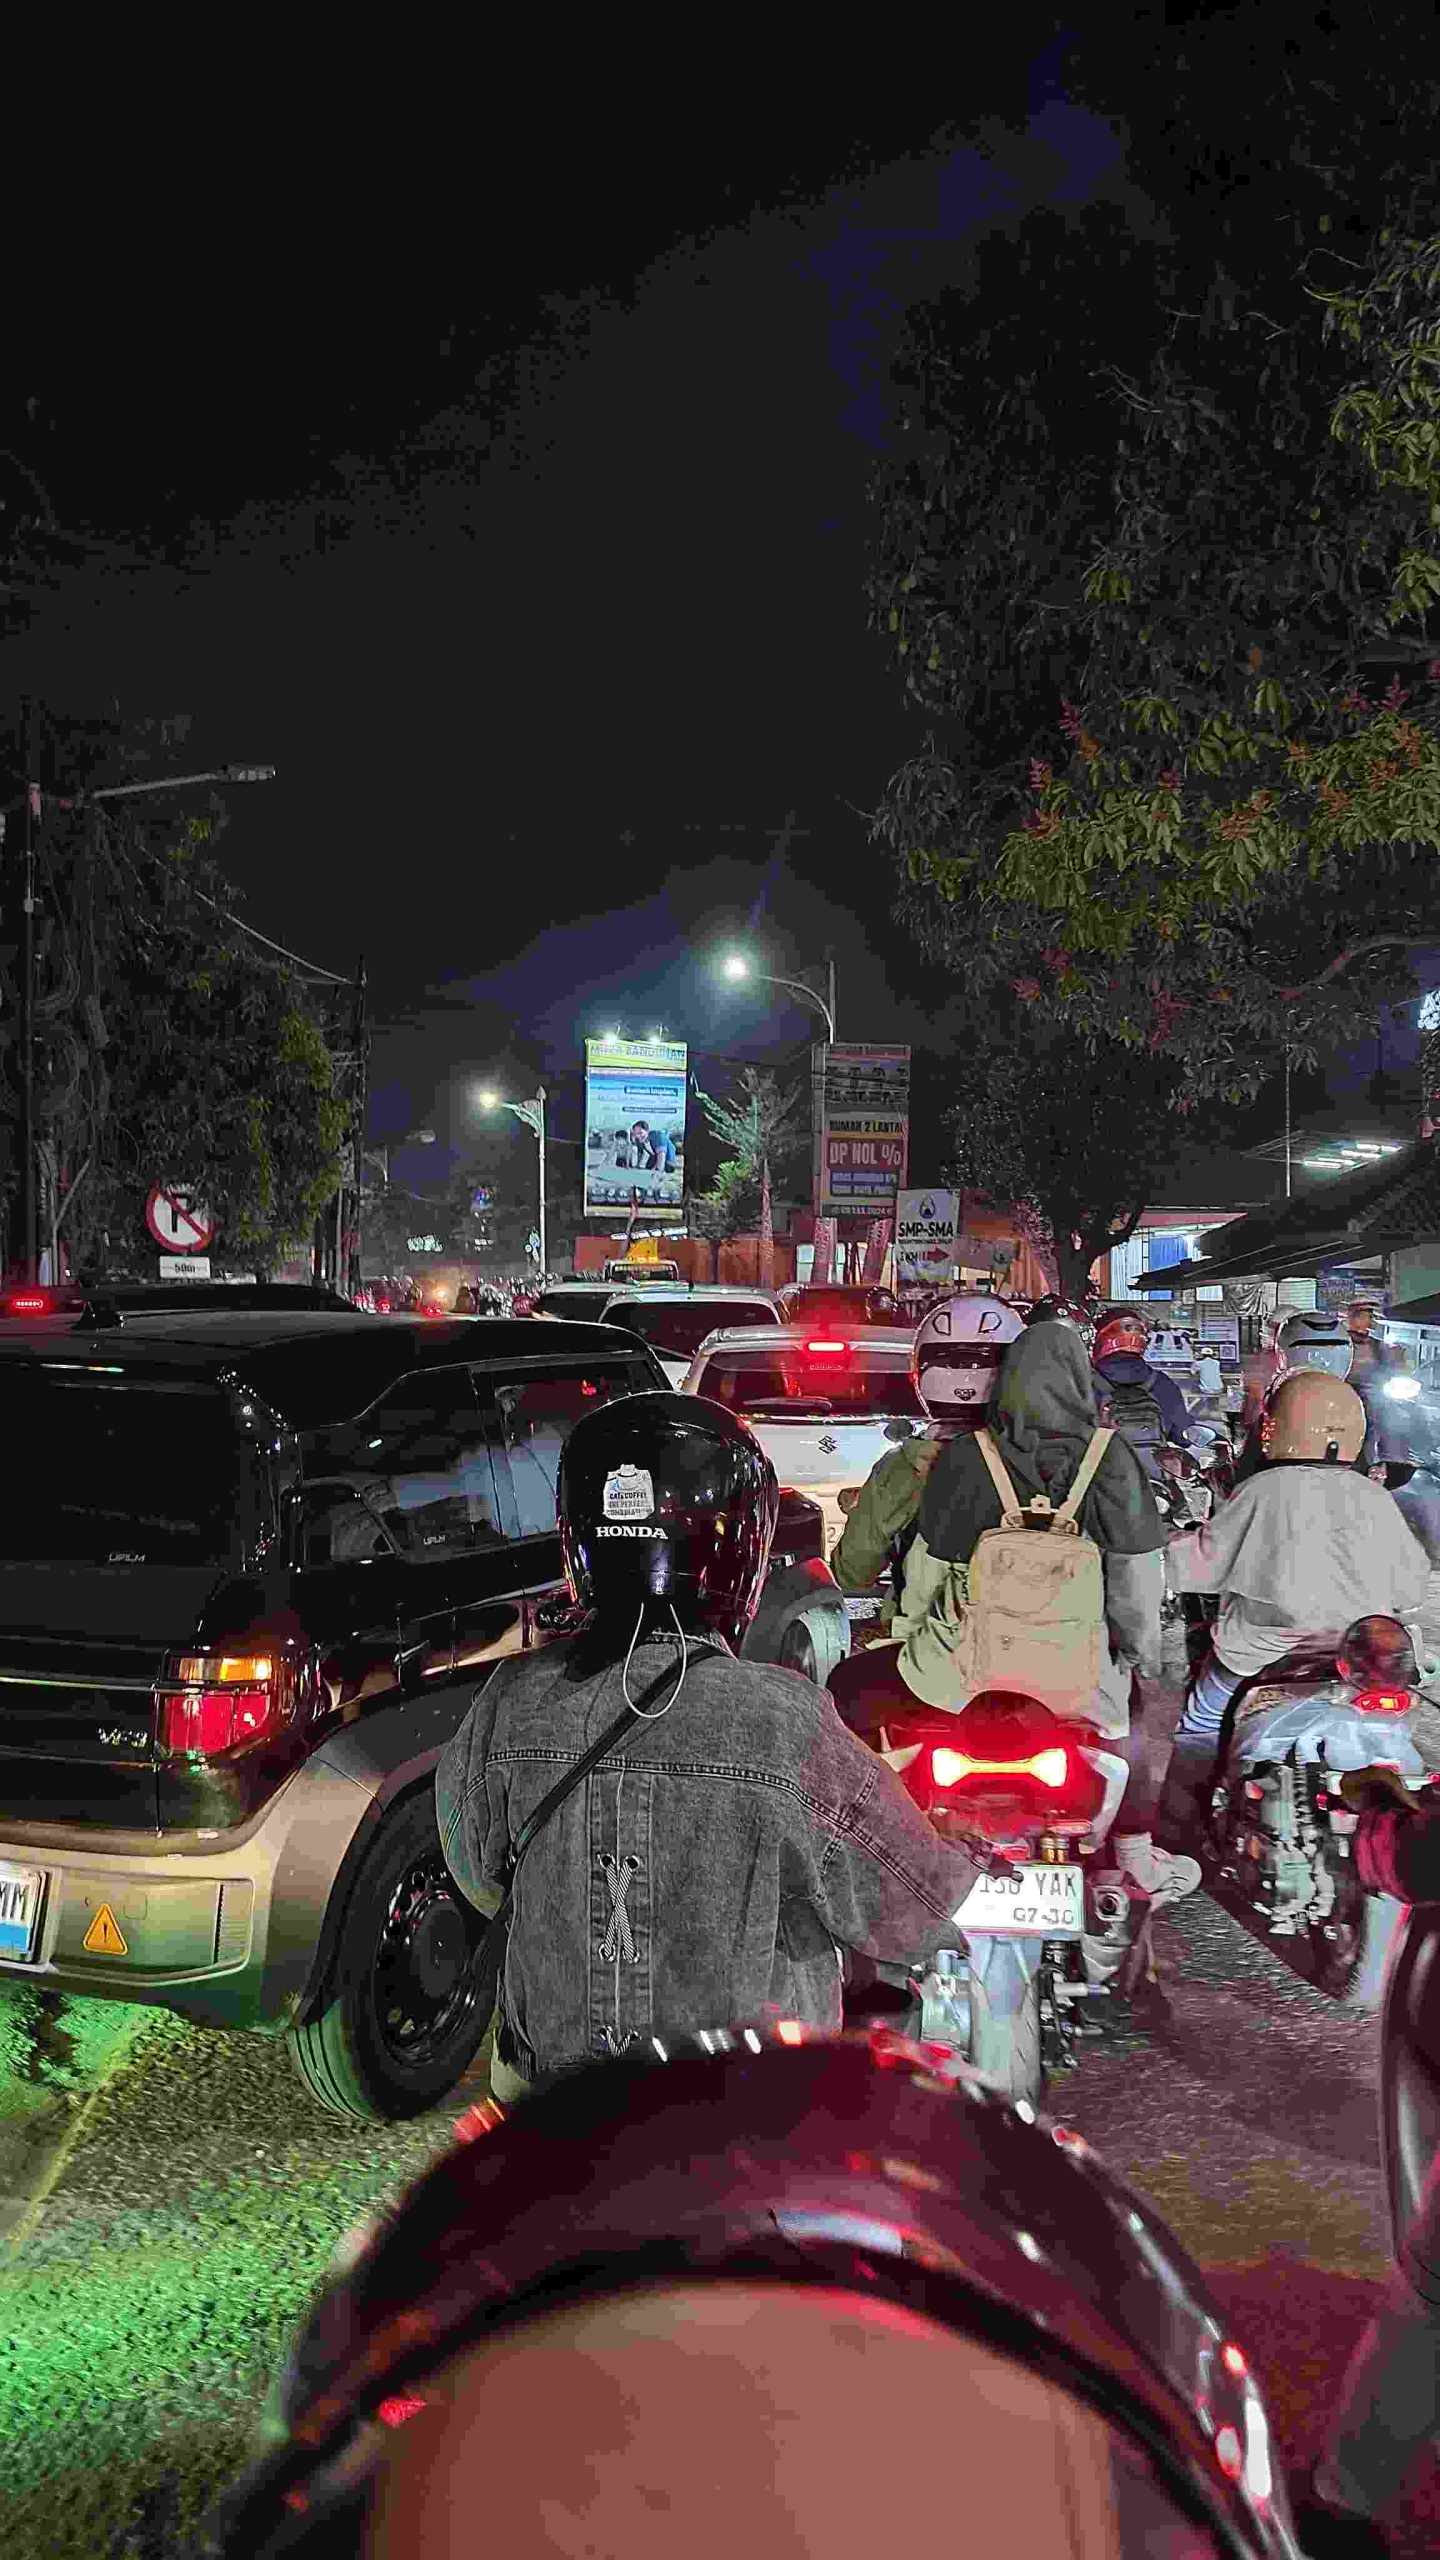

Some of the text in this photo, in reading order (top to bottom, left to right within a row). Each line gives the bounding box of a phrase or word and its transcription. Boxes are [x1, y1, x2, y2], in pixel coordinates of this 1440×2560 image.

[864, 1121, 872, 1132] 2
[829, 1142, 901, 1166] DP NOL %
[899, 1221, 954, 1238] SMP-SMA
[595, 1525, 669, 1540] HONDA
[1035, 1872, 1079, 1898] YAK
